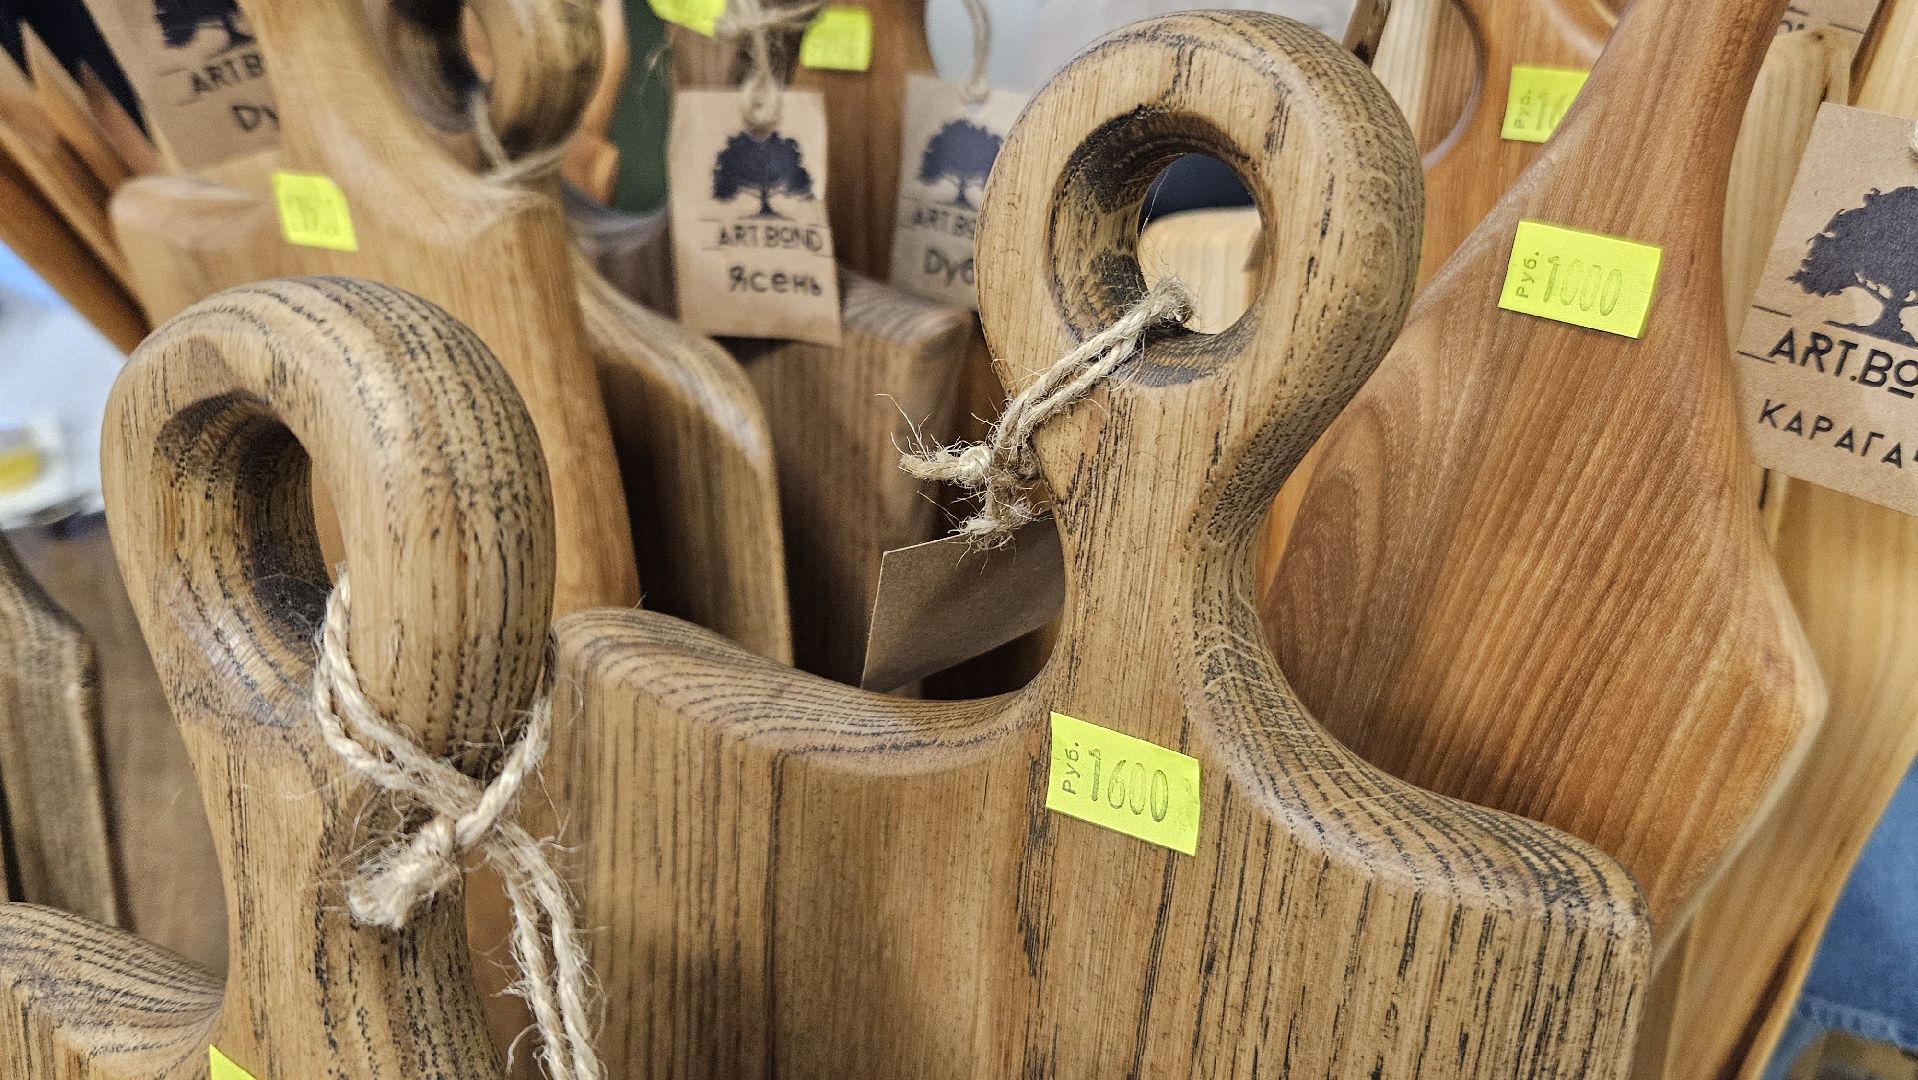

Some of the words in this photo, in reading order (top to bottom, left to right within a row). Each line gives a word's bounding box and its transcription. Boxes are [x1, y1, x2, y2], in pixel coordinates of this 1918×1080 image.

[728, 265, 822, 296] Ясень
[1515, 251, 1540, 299] Руб.
[1542, 255, 1623, 317] 1000
[1758, 398, 1918, 469] КАРАГА
[1061, 741, 1081, 796] Руб.
[1088, 748, 1169, 823] 1600
